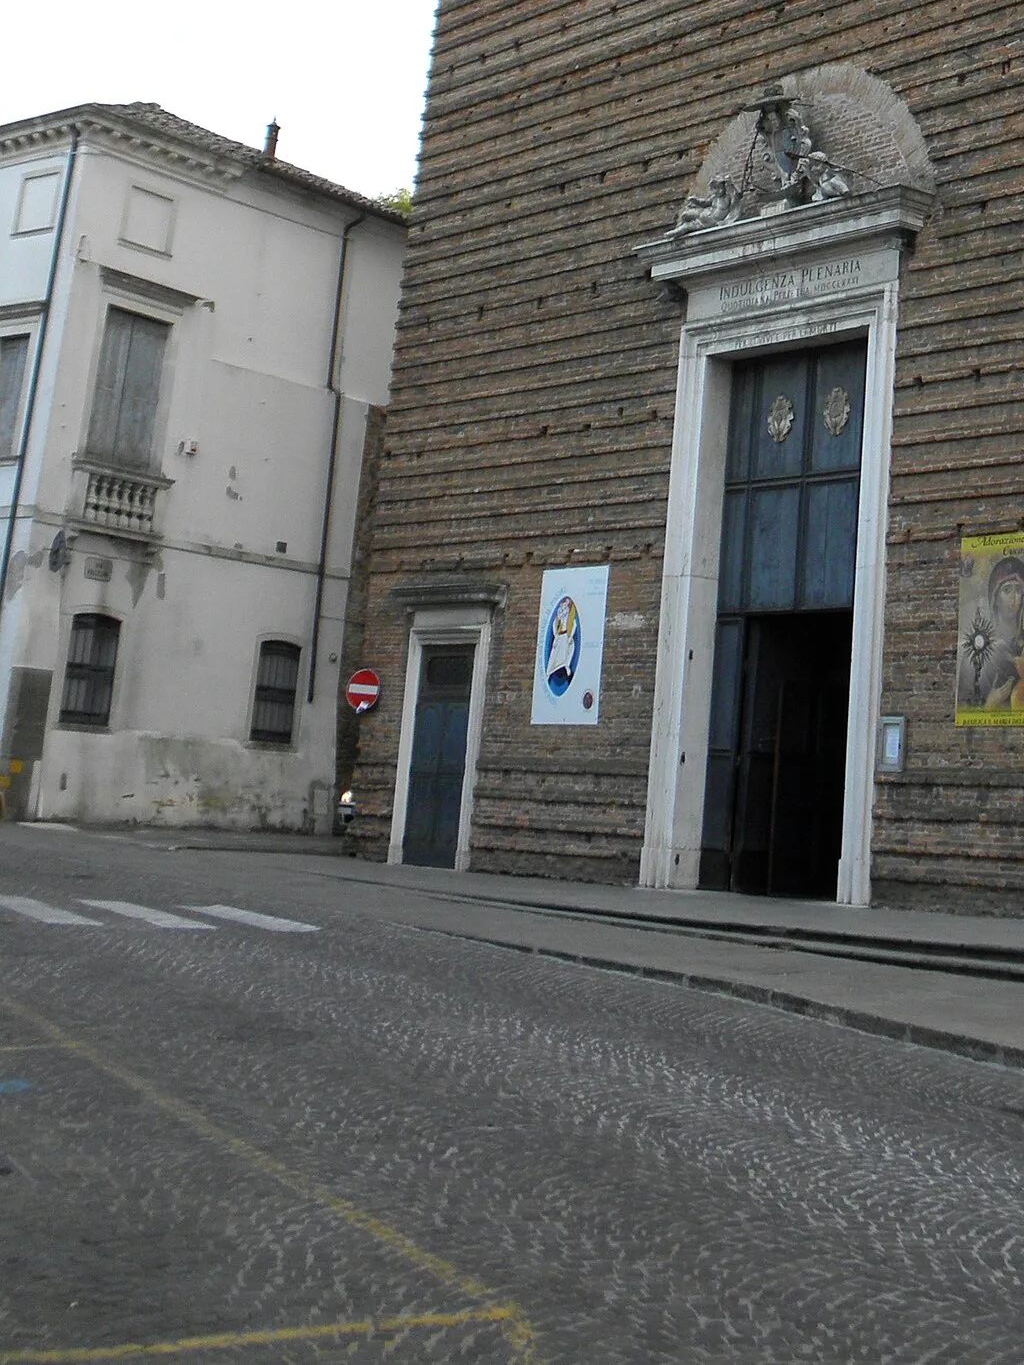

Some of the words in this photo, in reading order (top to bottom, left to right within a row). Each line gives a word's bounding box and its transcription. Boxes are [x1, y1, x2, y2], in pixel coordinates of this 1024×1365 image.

[720, 274, 794, 300] INDULGENZA
[801, 260, 861, 282] PLENARIA
[971, 536, 1024, 548] Adorazione
